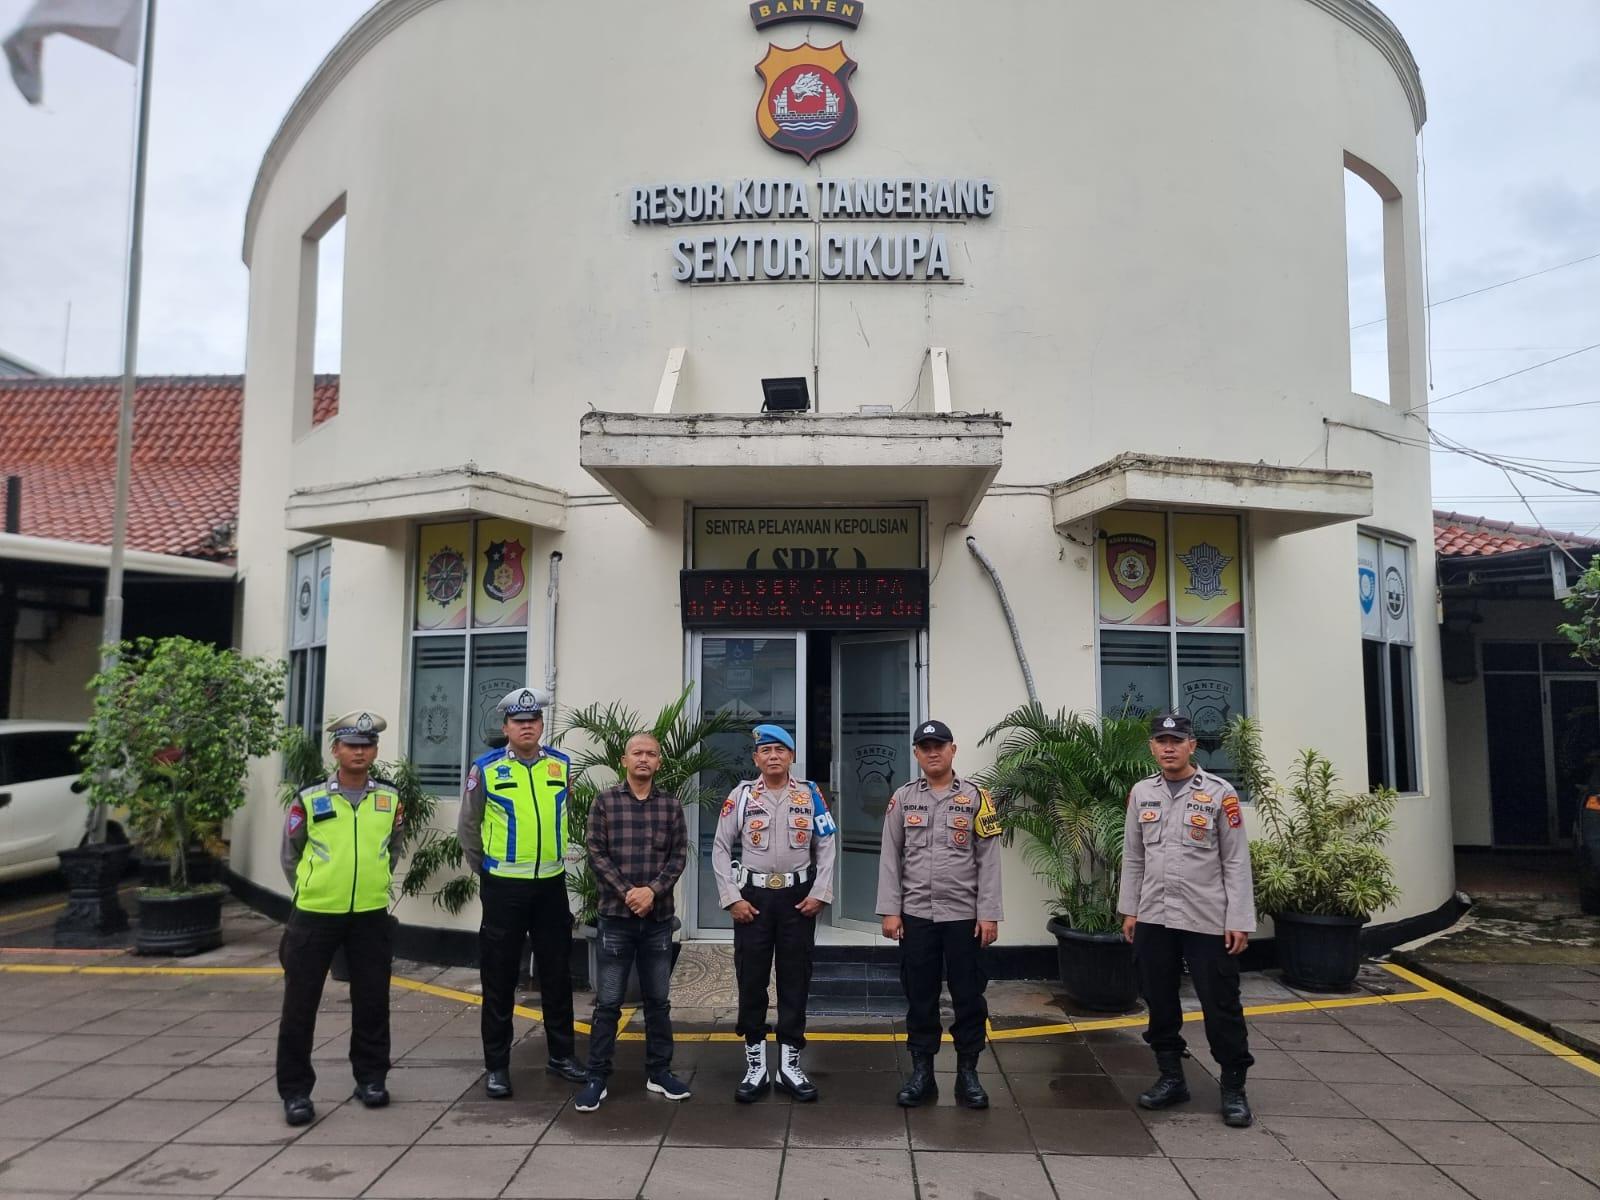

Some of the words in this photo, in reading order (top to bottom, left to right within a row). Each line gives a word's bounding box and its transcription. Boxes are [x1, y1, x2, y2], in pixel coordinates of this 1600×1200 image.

[759, 0, 854, 17] BANTEN
[632, 184, 725, 224] RESOR
[733, 179, 809, 219] KOTA
[816, 178, 995, 217] TANGERANG
[672, 233, 810, 282] SEKTOR
[821, 231, 952, 280] CIKUPA
[705, 519, 754, 535] SENTRA
[758, 519, 831, 535] PELAYANAN
[834, 518, 909, 534] KEPOLISIAN
[704, 579, 800, 595] POLSEK
[812, 579, 904, 594] CIKUPA
[481, 681, 517, 690] BANTEN
[1186, 682, 1229, 692] BANTEN
[857, 747, 894, 757] BANTEN
[789, 806, 812, 815] POLRI
[948, 805, 974, 815] POLRI
[1186, 802, 1214, 813] POLRI
